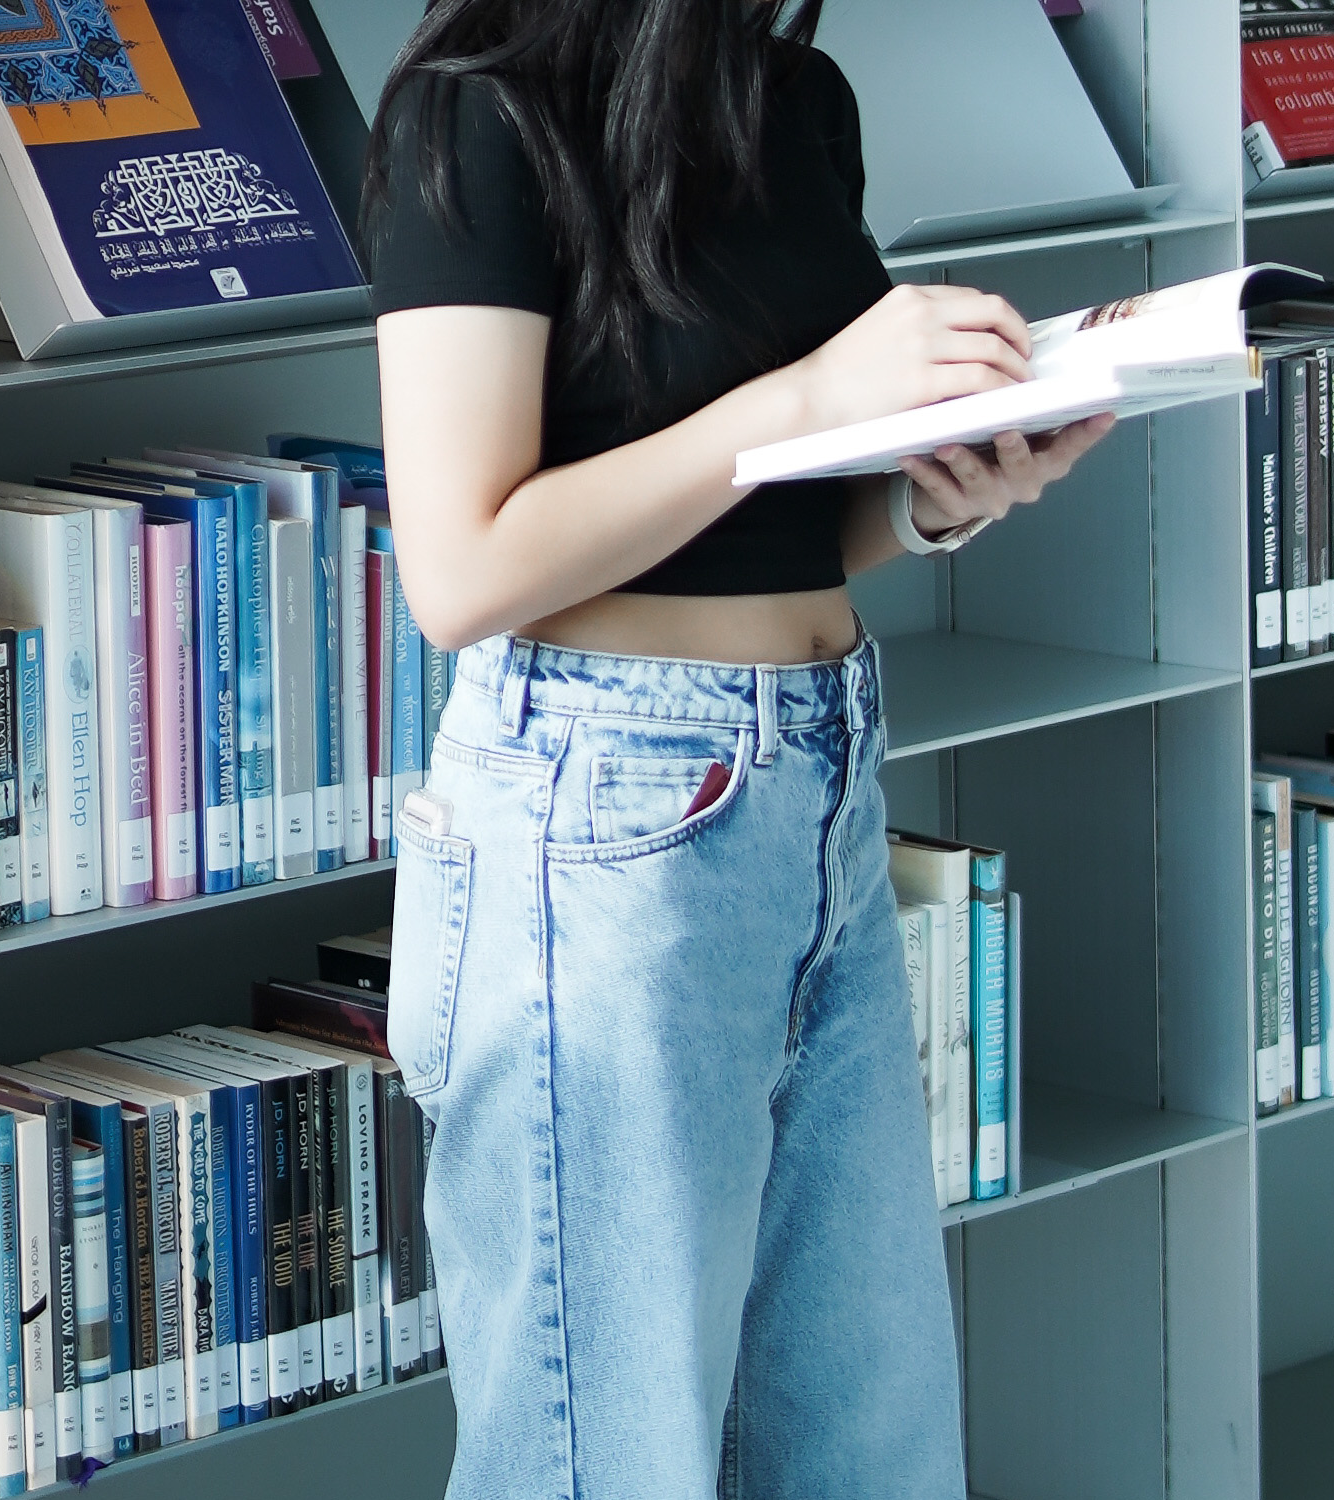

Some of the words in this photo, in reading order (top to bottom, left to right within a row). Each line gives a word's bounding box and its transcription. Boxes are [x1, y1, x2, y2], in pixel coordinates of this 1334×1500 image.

[1251, 48, 1285, 68] the
[1305, 70, 1332, 82] death
[1263, 453, 1276, 524] Malinche's
[214, 516, 228, 565] NALO
[1263, 526, 1275, 584] Children
[173, 565, 187, 633] hooper
[216, 566, 230, 672] HOPKINSON
[127, 650, 145, 714] Alice
[71, 710, 89, 770] Ellen
[129, 723, 146, 745] in
[130, 757, 147, 806] Bed
[1263, 839, 1273, 883] LIKE
[955, 895, 969, 942] Miss
[1263, 892, 1273, 918] TO
[986, 899, 1004, 989] TRIGGER
[1263, 926, 1273, 960] DIE
[955, 953, 968, 1021] Austen
[986, 1000, 1003, 1082] MORTIS
[154, 1112, 171, 1171] ROBERT
[246, 1103, 254, 1145] RYDER
[299, 1121, 308, 1169] HORN
[329, 1116, 338, 1164] HORN
[359, 1104, 369, 1172] LOVING
[133, 1128, 146, 1177] Robert
[247, 1150, 255, 1166] OF
[275, 1129, 285, 1178] HORN
[195, 1178, 205, 1193] TO
[362, 1181, 371, 1238] FRANK
[112, 1205, 122, 1238] The
[137, 1196, 148, 1249] Horton
[159, 1191, 174, 1254] HORTON
[195, 1196, 205, 1225] COME
[273, 1219, 291, 1247] THE
[297, 1211, 313, 1239] THE
[328, 1205, 344, 1233] THE
[273, 1252, 293, 1286] VOID
[299, 1242, 315, 1272] LINE
[328, 1235, 346, 1288] SOURCE
[60, 1243, 74, 1336] RAINBOW
[112, 1245, 123, 1323] Hanging
[160, 1279, 176, 1305] MAN
[162, 1324, 178, 1352] THE
[198, 1309, 208, 1334] DARA
